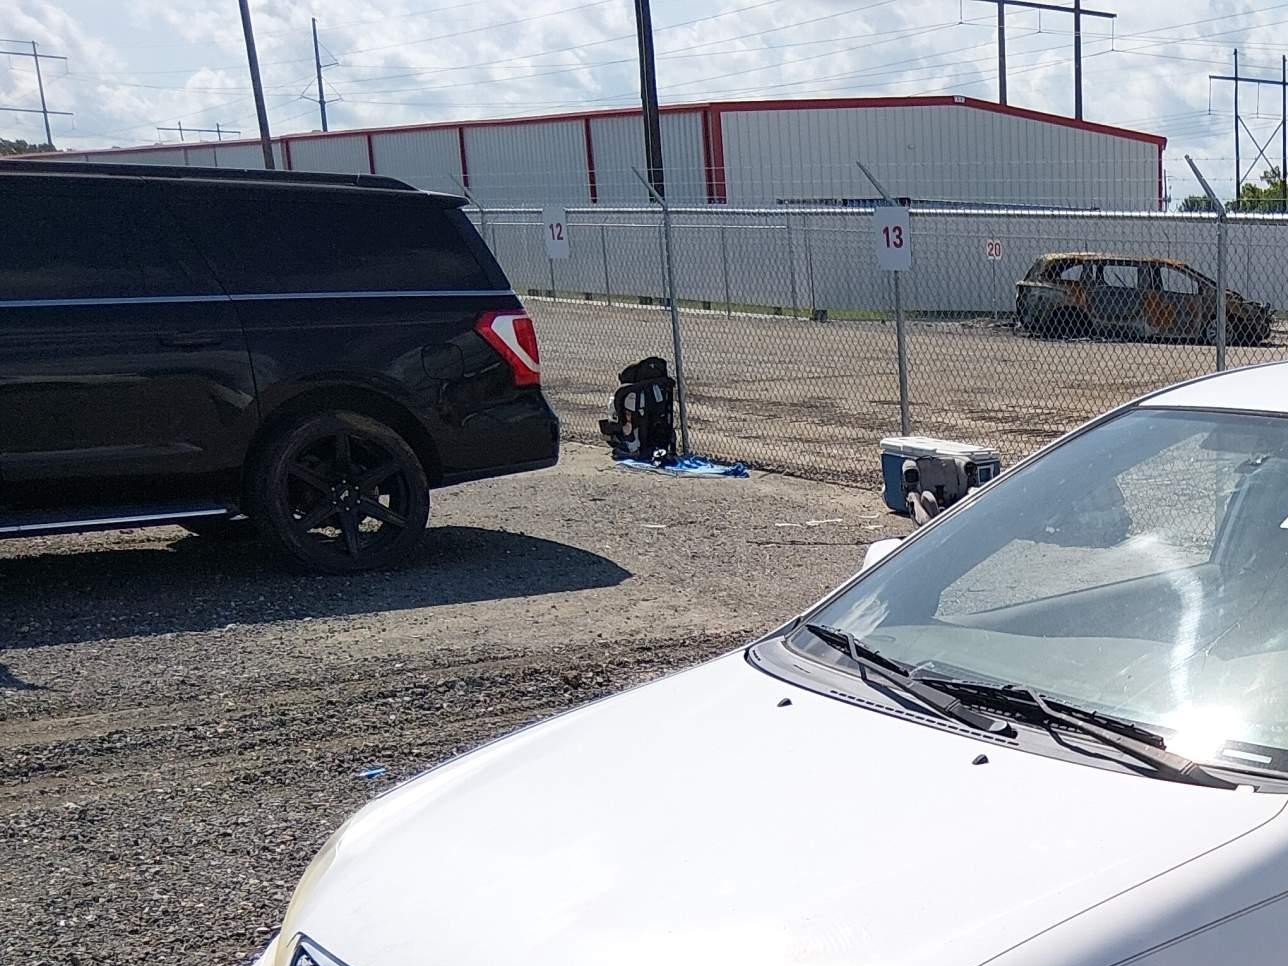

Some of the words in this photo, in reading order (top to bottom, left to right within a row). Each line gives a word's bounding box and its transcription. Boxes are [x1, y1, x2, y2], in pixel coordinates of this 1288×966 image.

[549, 223, 564, 241] 12
[882, 225, 904, 249] 13
[987, 242, 1001, 257] 20
